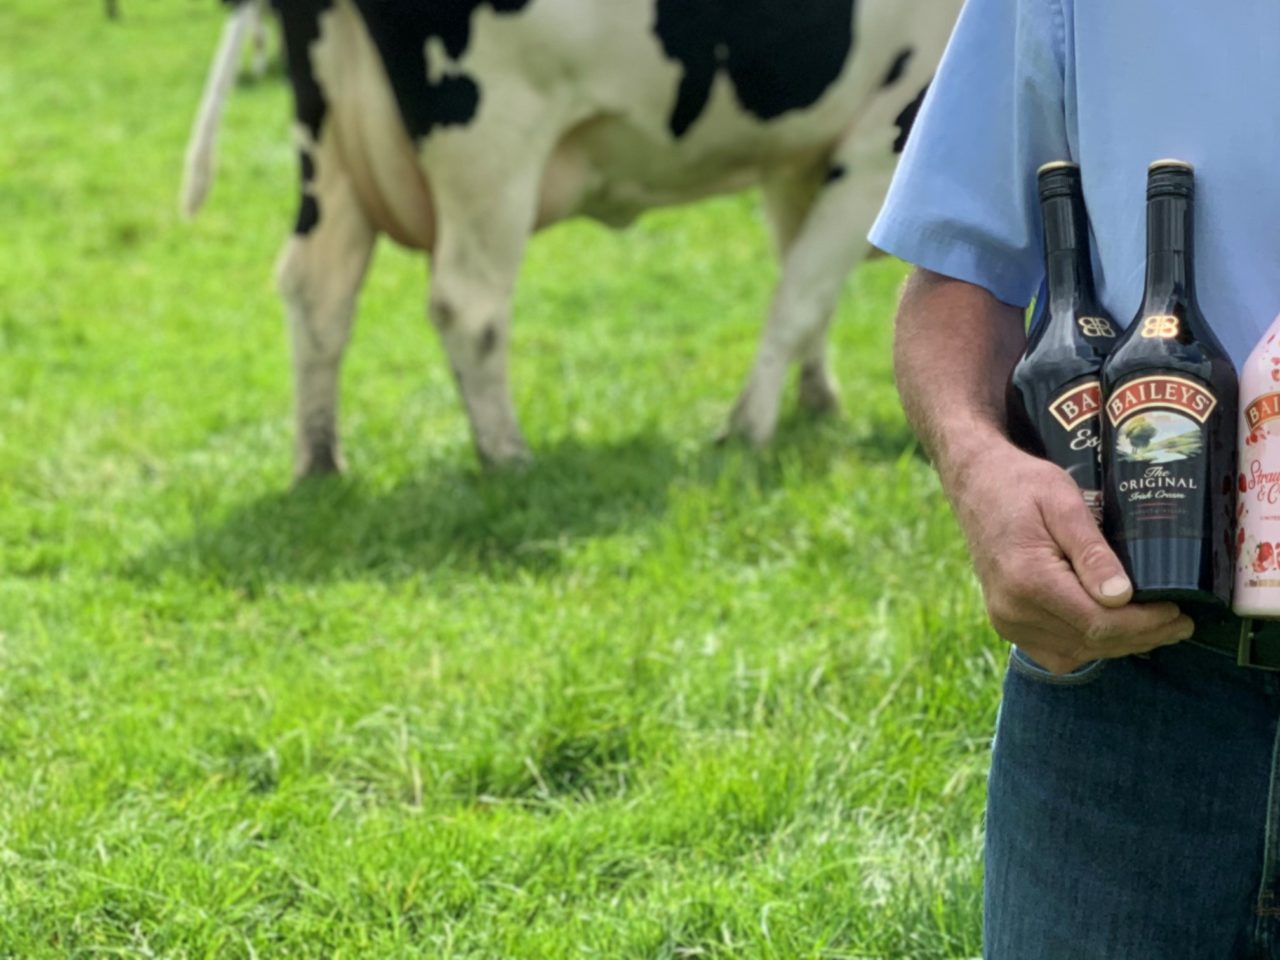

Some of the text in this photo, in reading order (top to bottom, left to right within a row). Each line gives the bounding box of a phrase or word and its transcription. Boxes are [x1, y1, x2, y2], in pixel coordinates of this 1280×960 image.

[1111, 383, 1209, 416] BAILEYS
[1143, 466, 1171, 478] The
[1120, 477, 1197, 492] ORIGINAL
